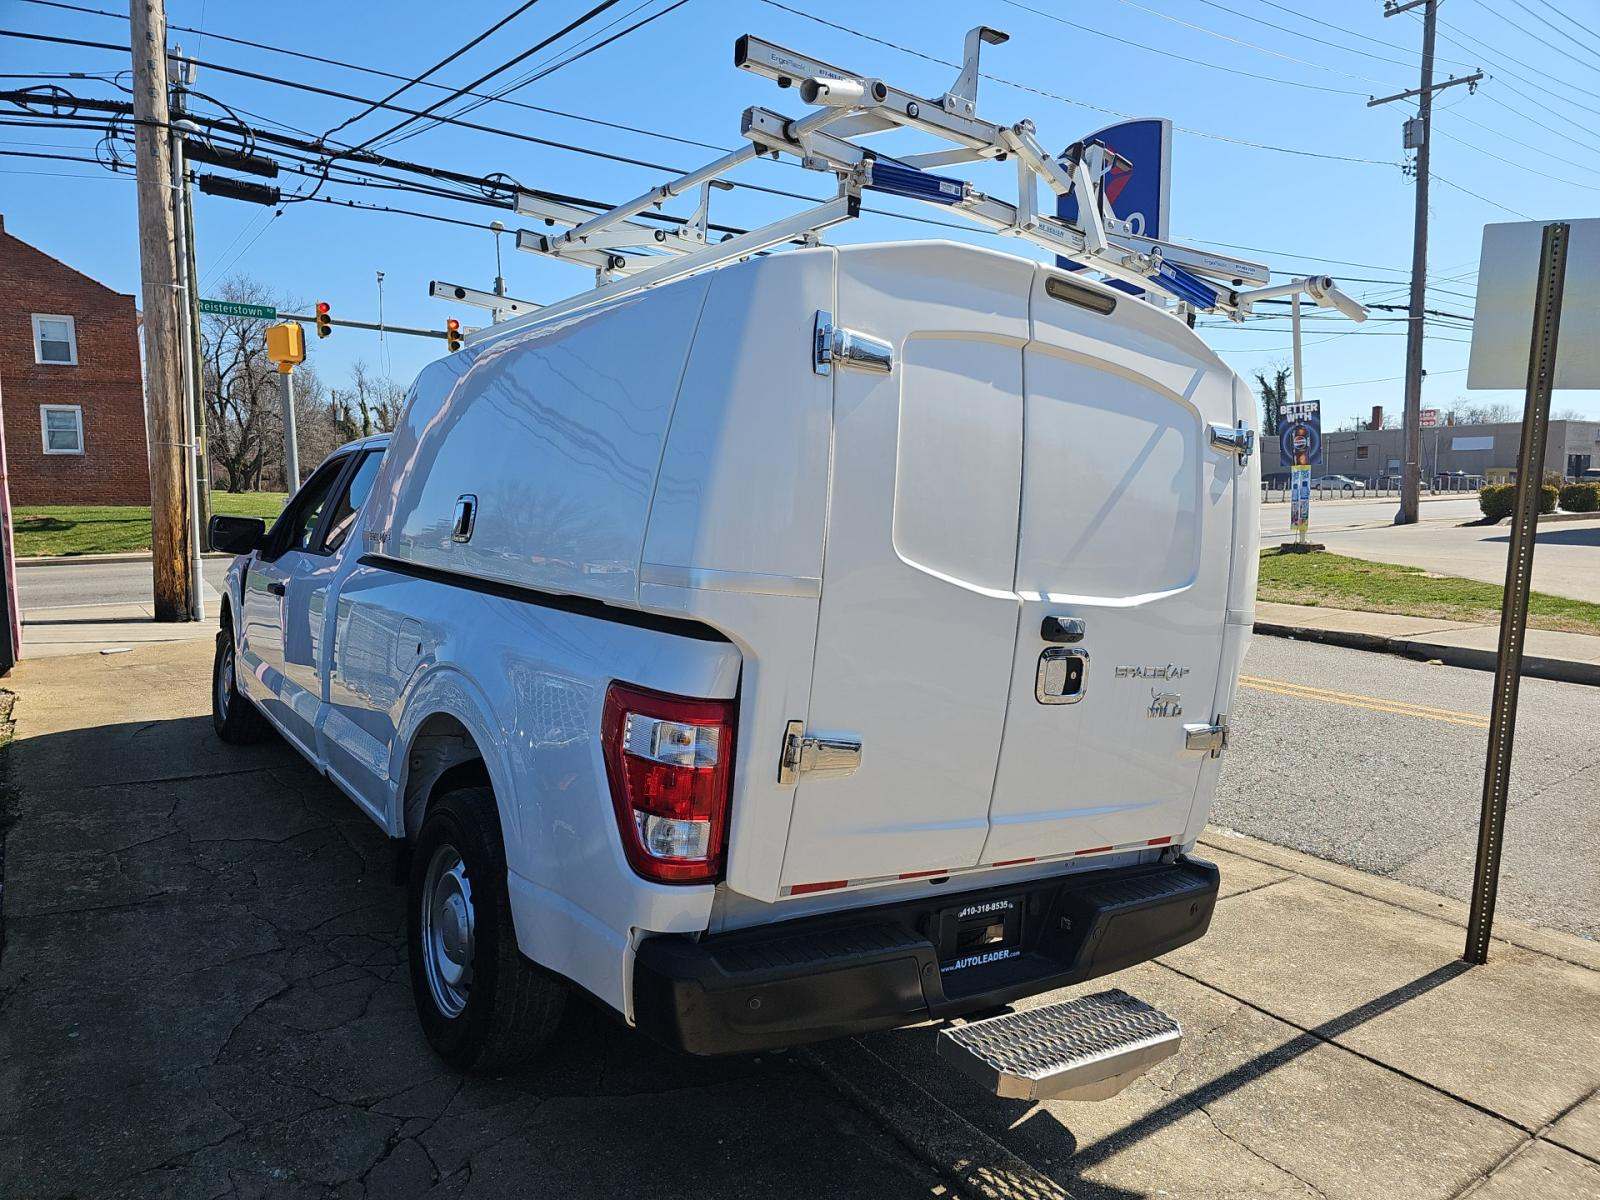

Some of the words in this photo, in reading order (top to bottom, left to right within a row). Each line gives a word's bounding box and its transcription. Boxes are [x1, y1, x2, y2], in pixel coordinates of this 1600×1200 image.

[199, 302, 263, 316] Reisterstown
[1280, 402, 1318, 415] BETTER
[962, 901, 1008, 917] 410-318-8535
